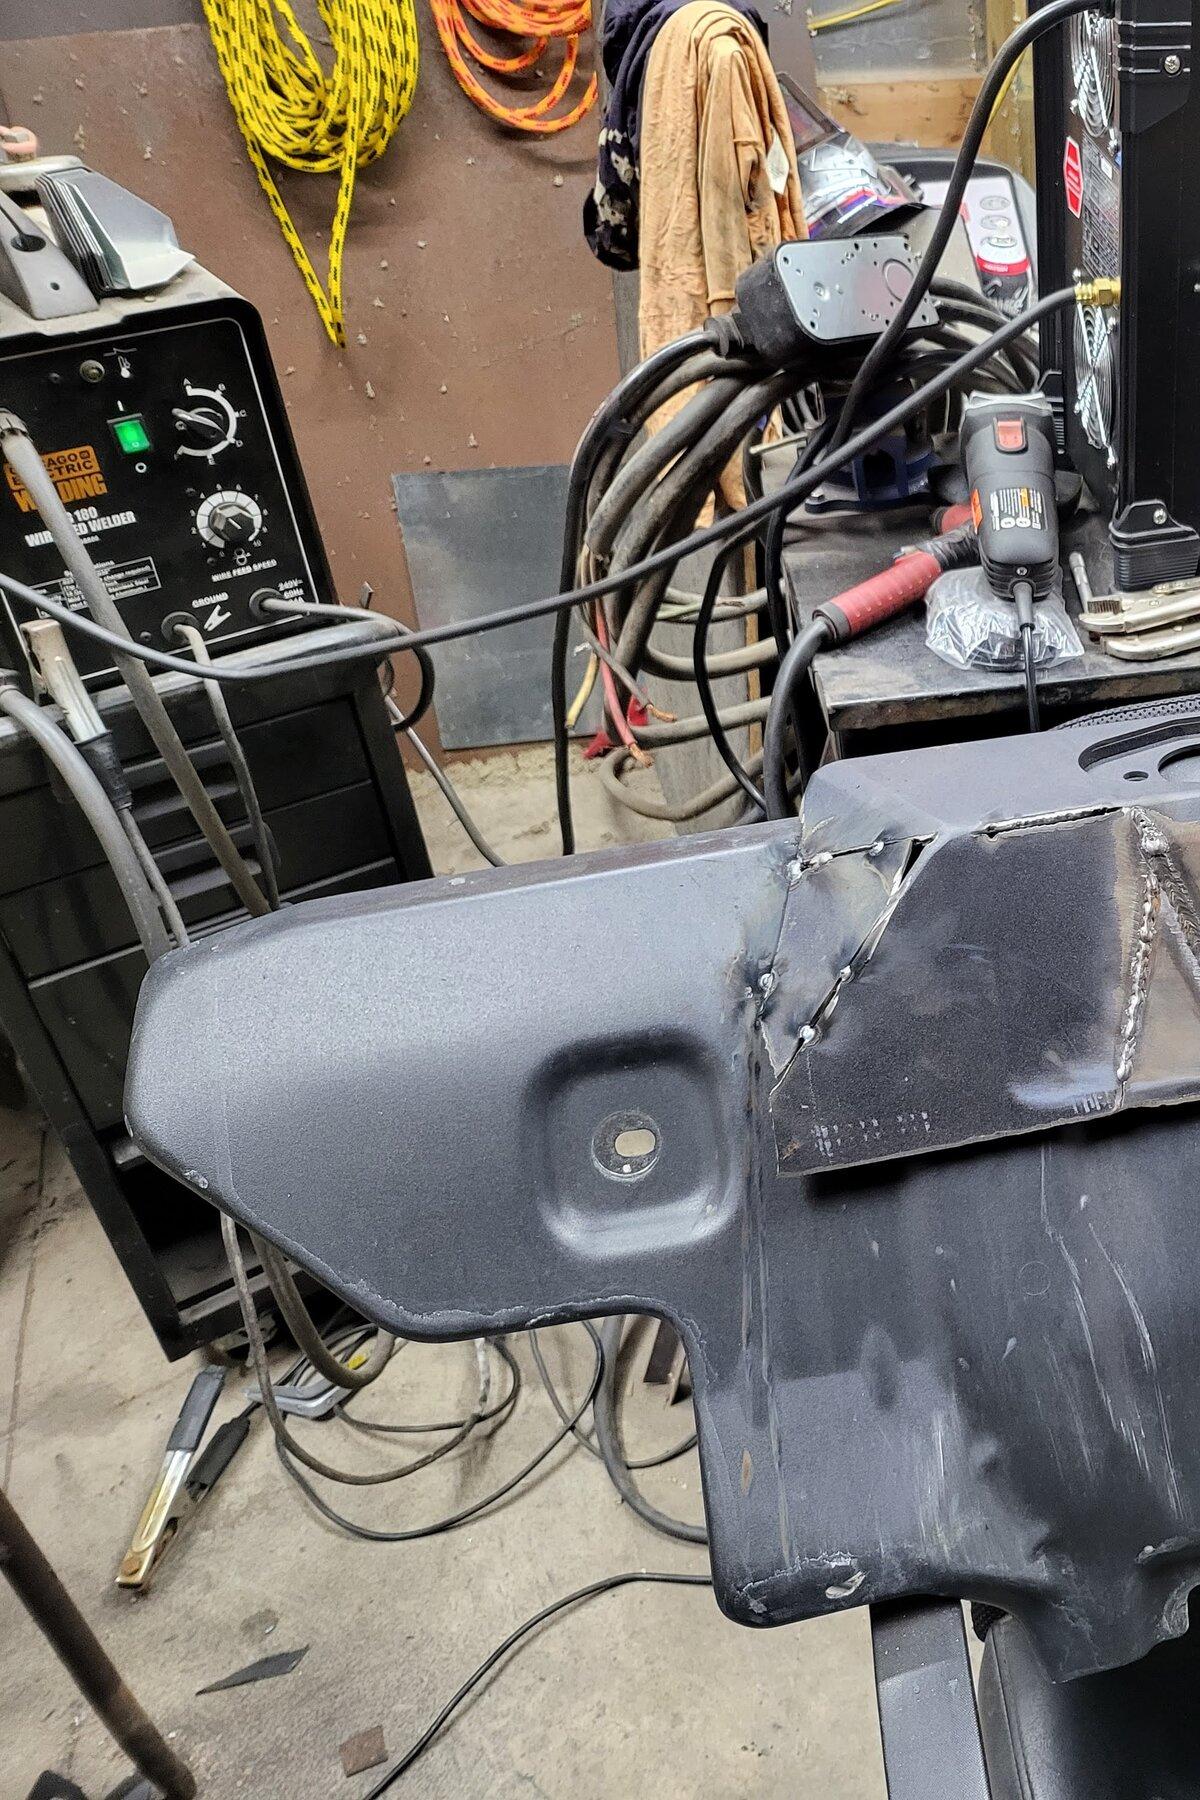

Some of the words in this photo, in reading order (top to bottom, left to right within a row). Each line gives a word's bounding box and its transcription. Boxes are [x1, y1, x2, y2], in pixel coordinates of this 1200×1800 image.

[74, 506, 98, 522] 180
[25, 531, 54, 547] WIR
[88, 510, 136, 532] WELDER
[211, 570, 232, 582] WIRE
[232, 564, 252, 576] FEED
[252, 558, 277, 572] SPEED
[192, 592, 229, 608] GROUND
